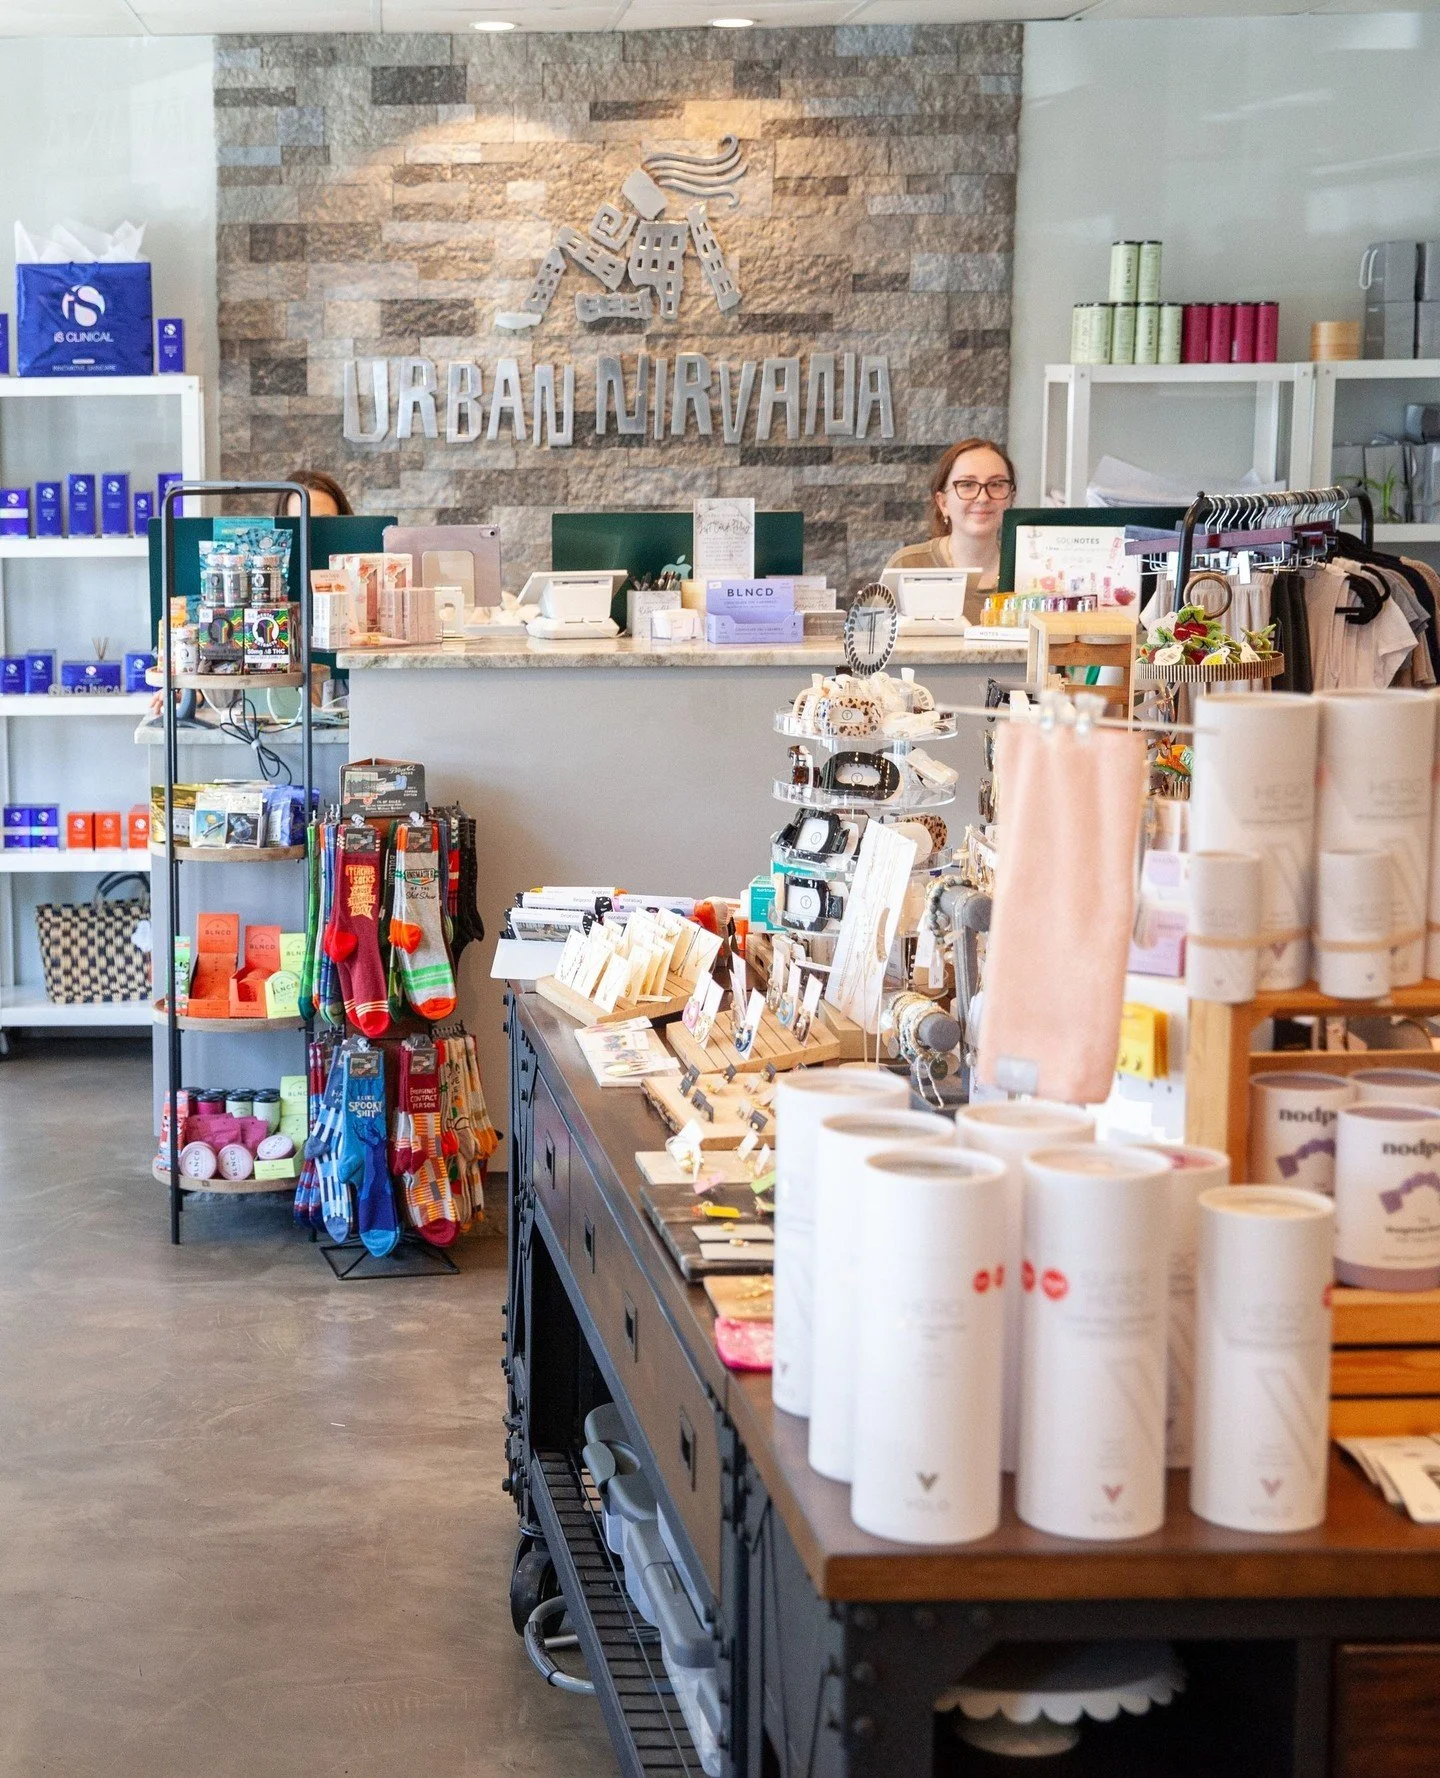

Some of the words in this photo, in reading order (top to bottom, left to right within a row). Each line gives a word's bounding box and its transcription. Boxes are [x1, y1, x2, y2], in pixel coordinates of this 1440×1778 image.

[66, 331, 114, 343] CLINICAL
[343, 357, 575, 447] URBAN
[595, 352, 894, 445] NIRVANA
[727, 587, 774, 597] BLNCD
[410, 1094, 438, 1102] CONTACT
[348, 1101, 383, 1113] SPOOKY
[356, 1109, 376, 1119] SHIT
